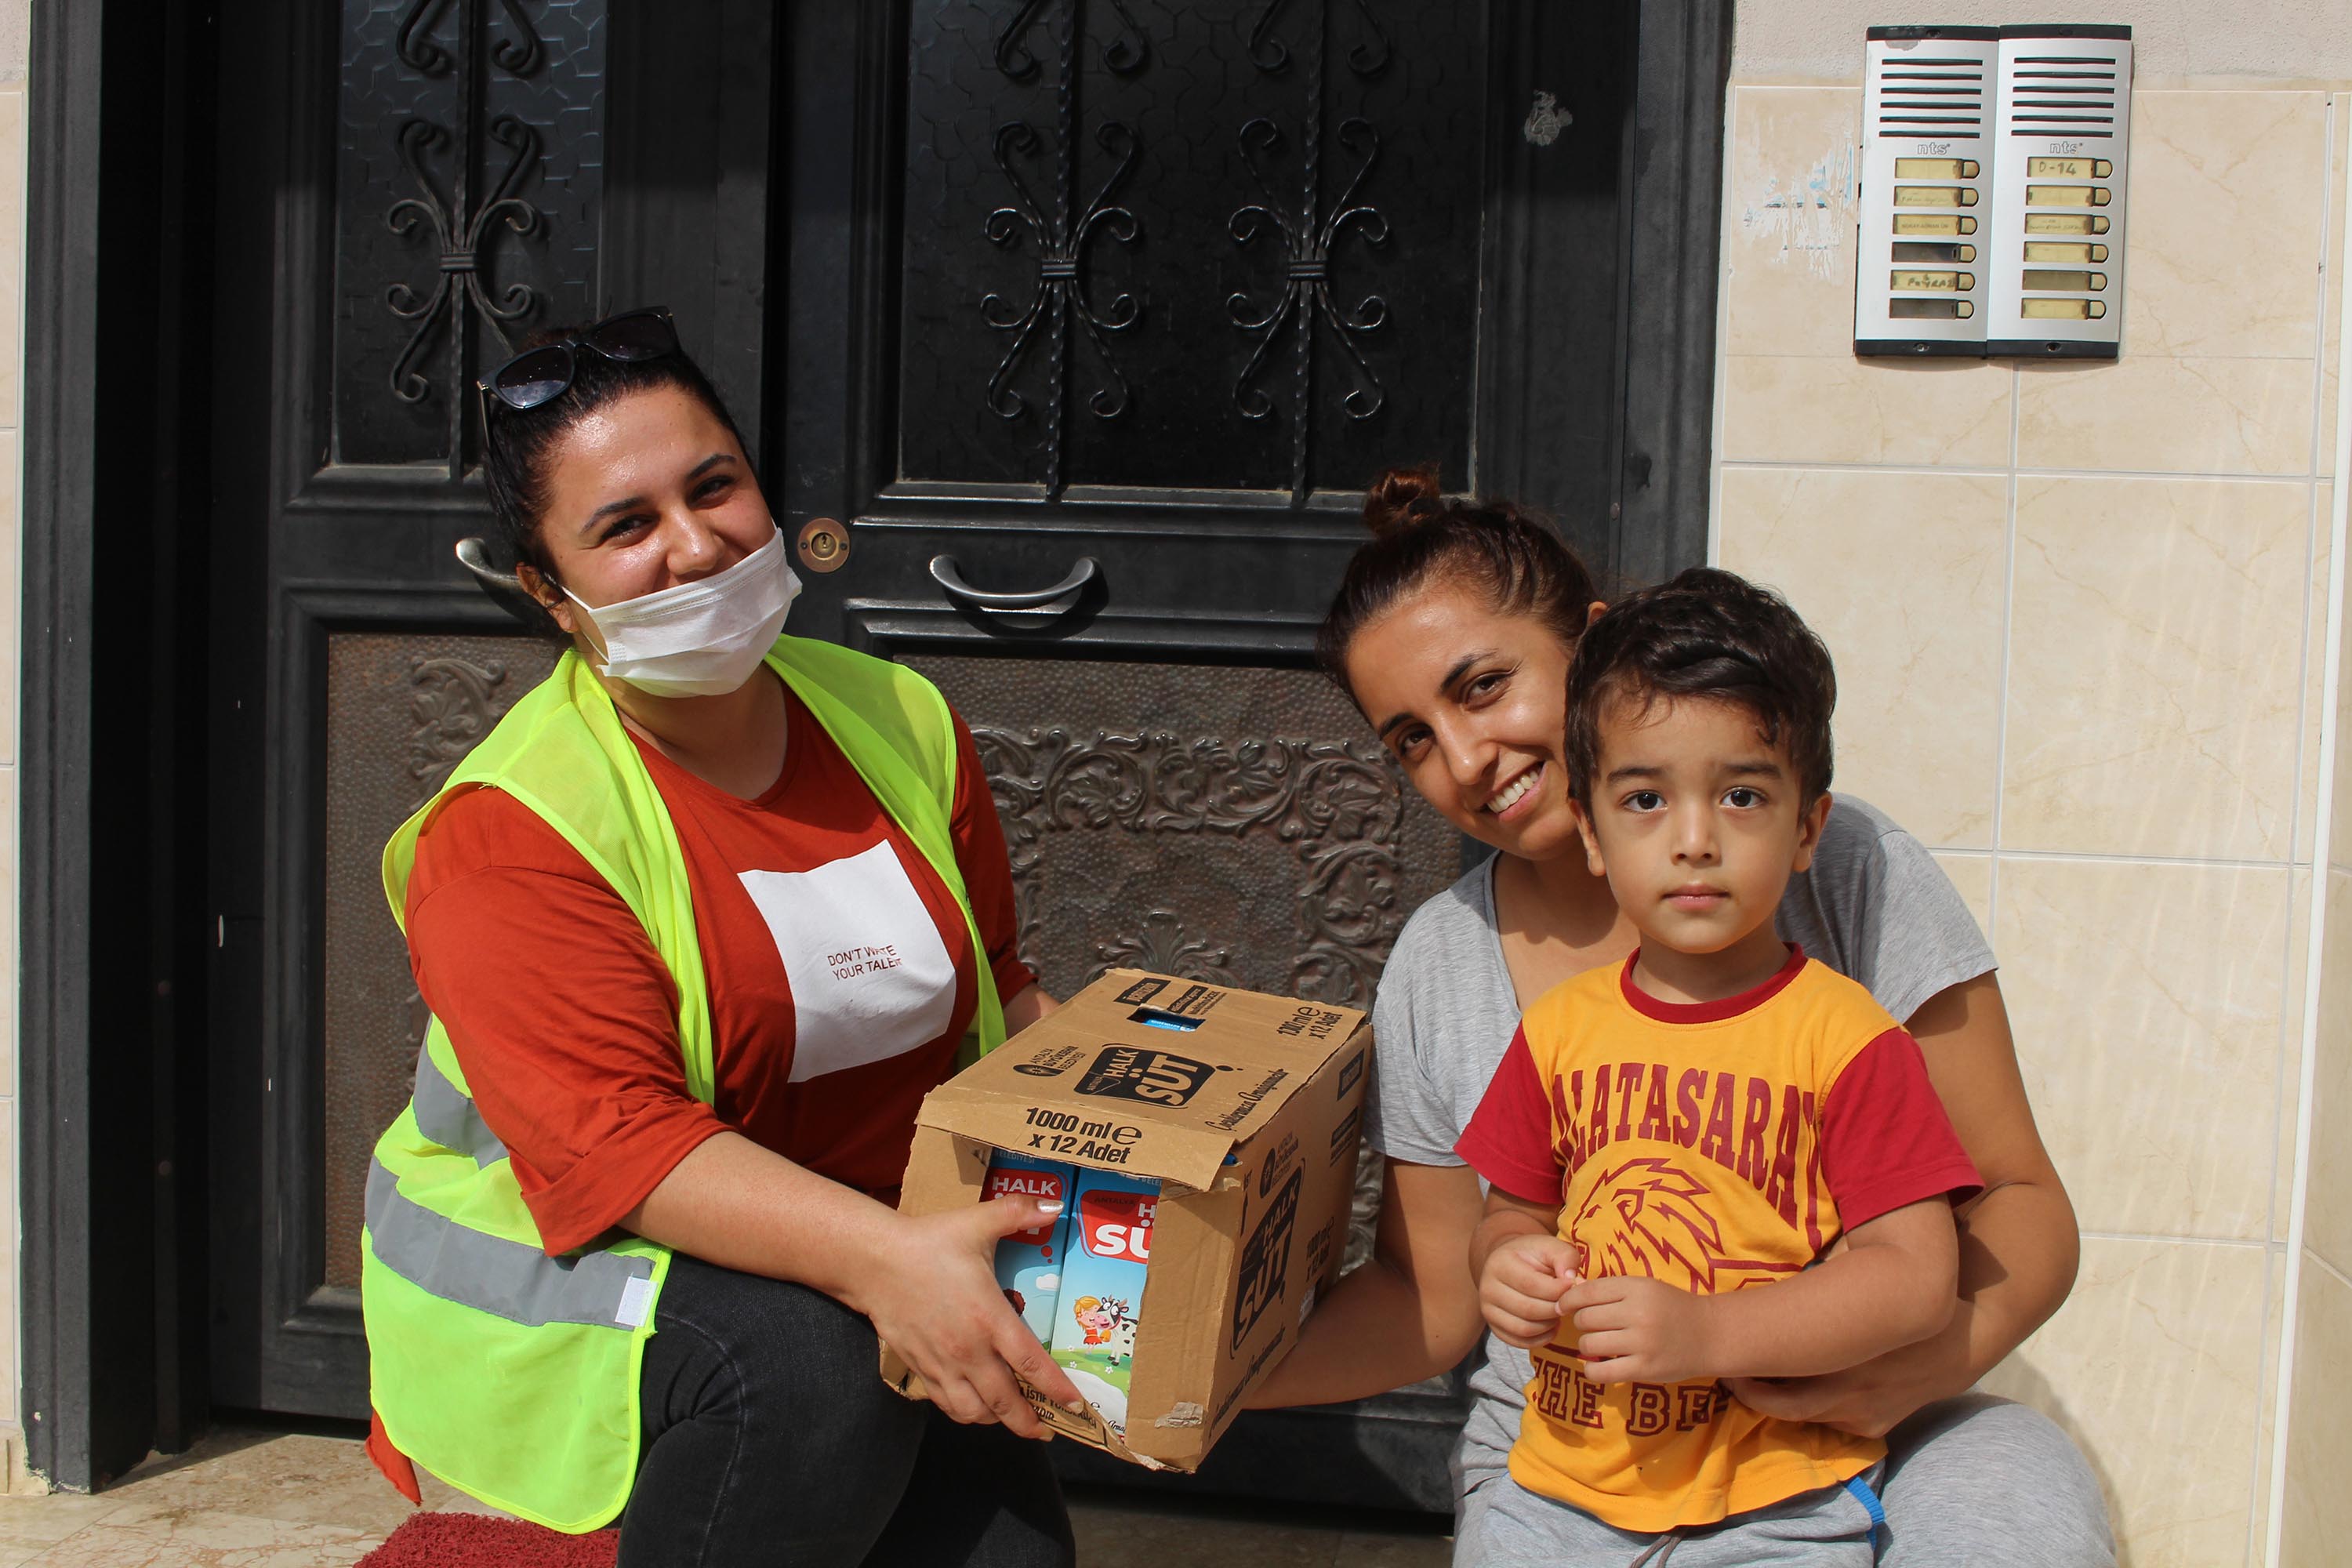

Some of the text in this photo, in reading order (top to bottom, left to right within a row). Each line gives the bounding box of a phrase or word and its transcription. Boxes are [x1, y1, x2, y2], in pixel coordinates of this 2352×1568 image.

[827, 948, 862, 966] DON'T
[832, 964, 865, 981] YOUR
[1102, 1049, 1139, 1078] HALK
[1129, 1054, 1199, 1105] SÜT
[1025, 1107, 1080, 1132] 1000
[1027, 1133, 1131, 1164] x 12 Adet
[1552, 1062, 1823, 1256] ALATASARAY
[991, 1176, 1056, 1196] HALK
